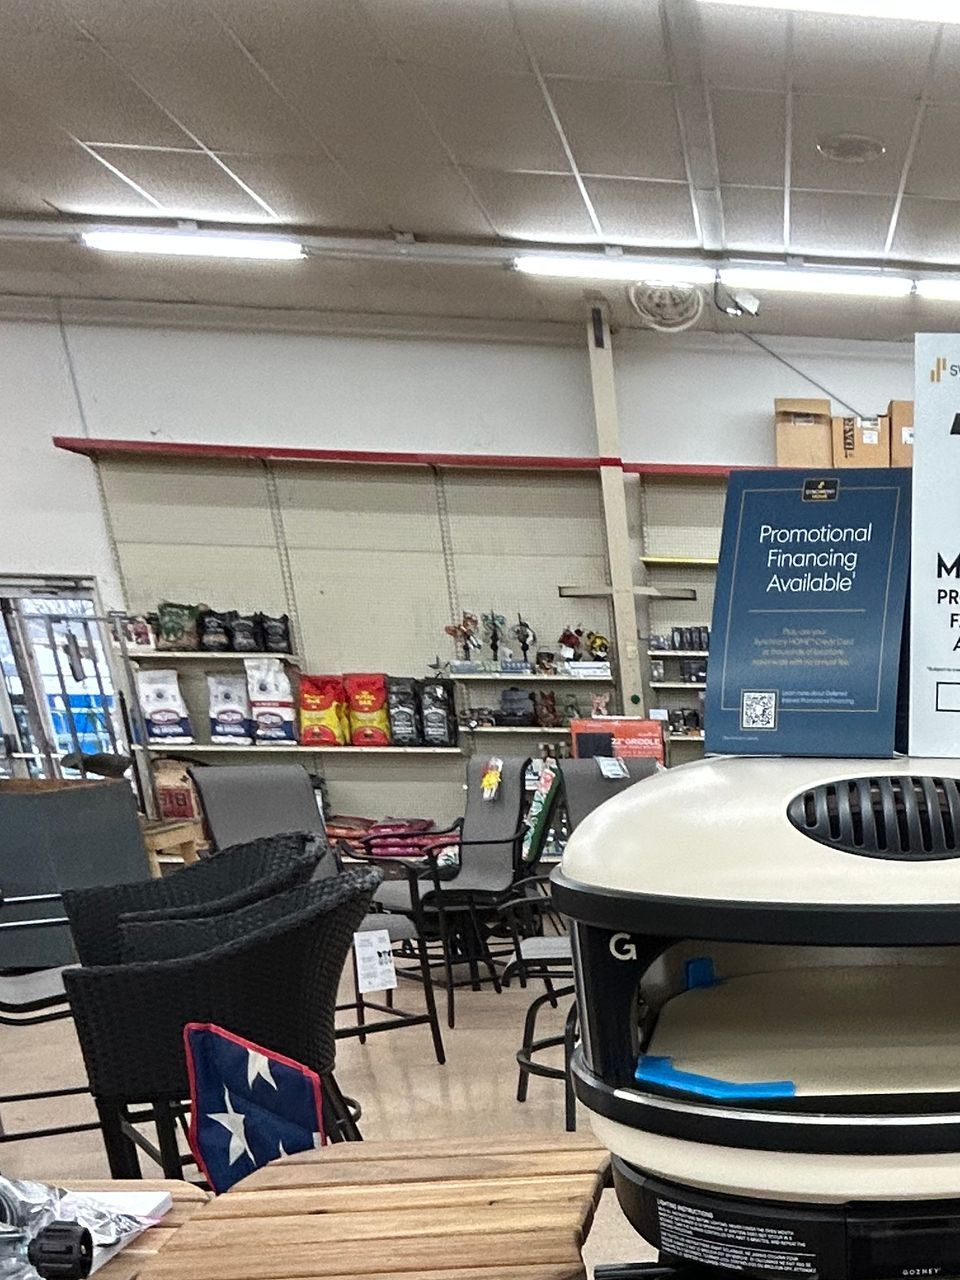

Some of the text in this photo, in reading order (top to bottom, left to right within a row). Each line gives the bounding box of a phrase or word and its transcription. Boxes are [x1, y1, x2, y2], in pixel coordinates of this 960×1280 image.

[759, 522, 873, 544] Promotional
[767, 548, 858, 571] Financing
[609, 932, 638, 960] G
